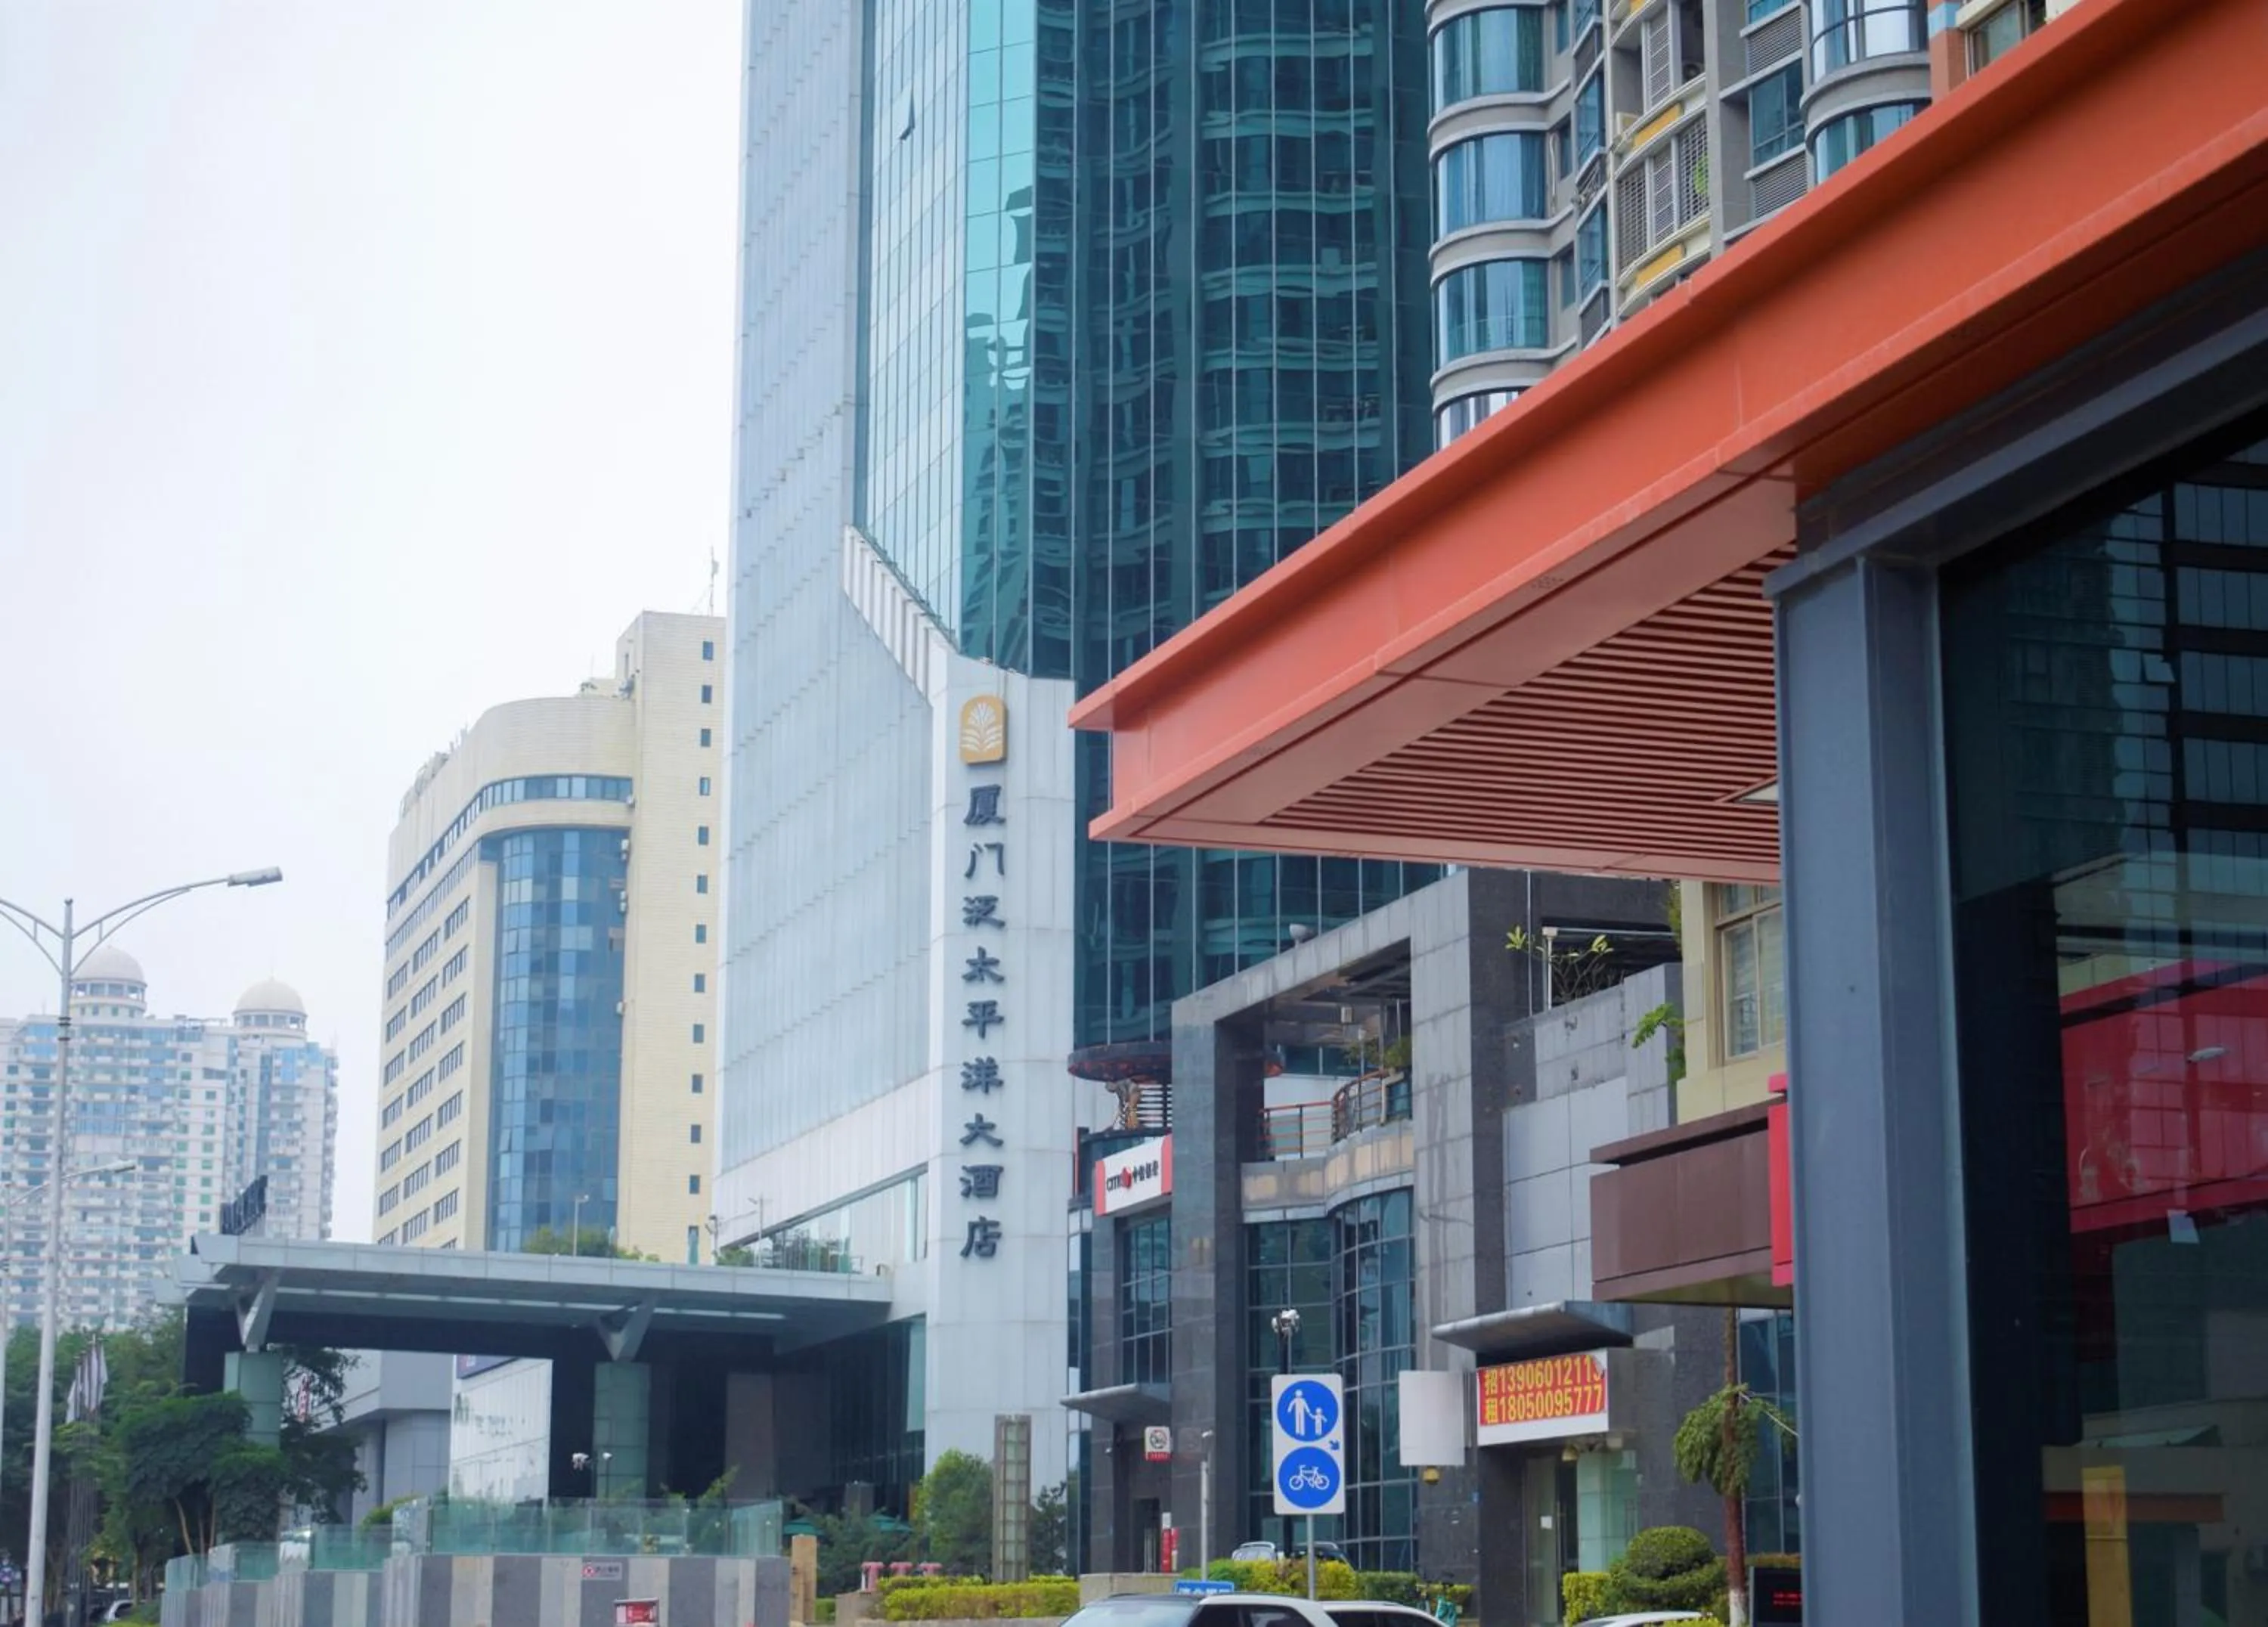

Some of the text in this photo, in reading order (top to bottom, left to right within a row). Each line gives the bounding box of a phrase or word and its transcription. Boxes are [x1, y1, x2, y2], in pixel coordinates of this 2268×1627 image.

[959, 784, 1006, 1259] 厦门泛太平洋大酒店
